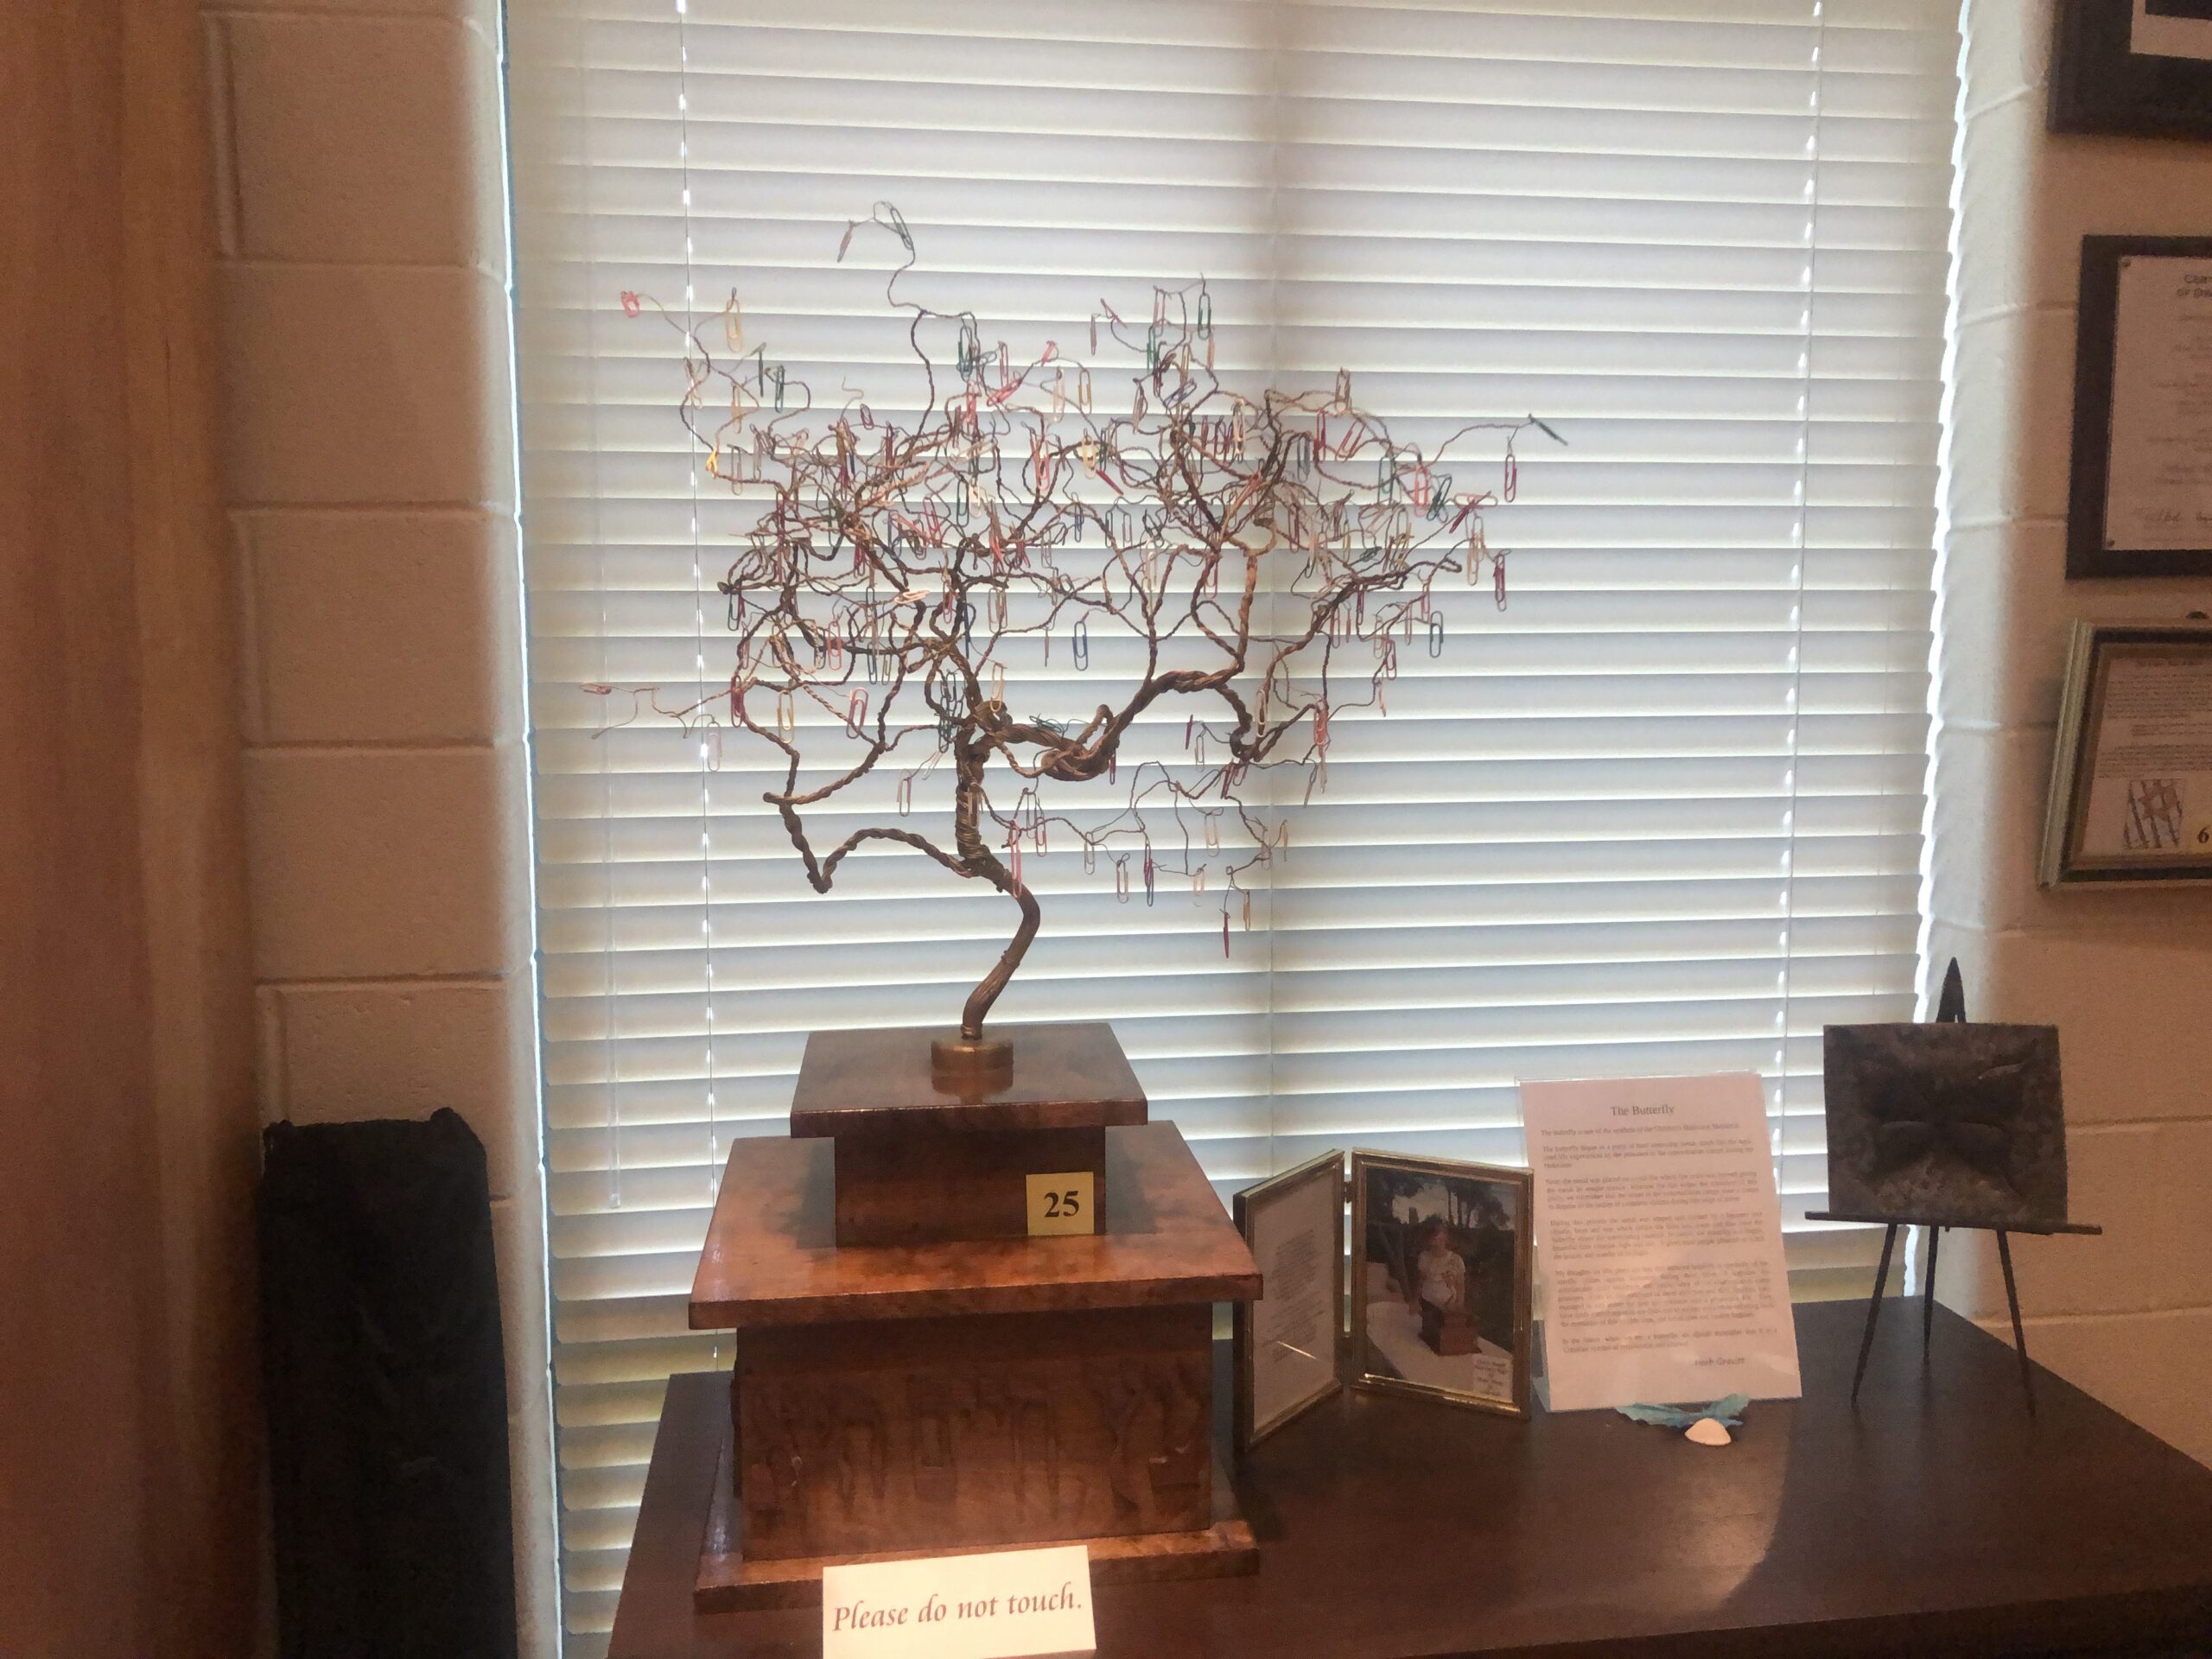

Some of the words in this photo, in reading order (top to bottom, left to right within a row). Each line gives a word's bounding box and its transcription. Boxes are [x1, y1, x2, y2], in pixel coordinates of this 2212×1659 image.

[2196, 825, 2211, 844] 6
[1610, 1106, 1630, 1116] The
[1632, 1104, 1675, 1116] Butterfly
[1044, 1190, 1080, 1218] 25
[832, 1599, 909, 1631] Please
[918, 1593, 947, 1623] do
[957, 1597, 999, 1619] not
[1007, 1581, 1082, 1615] touch.
